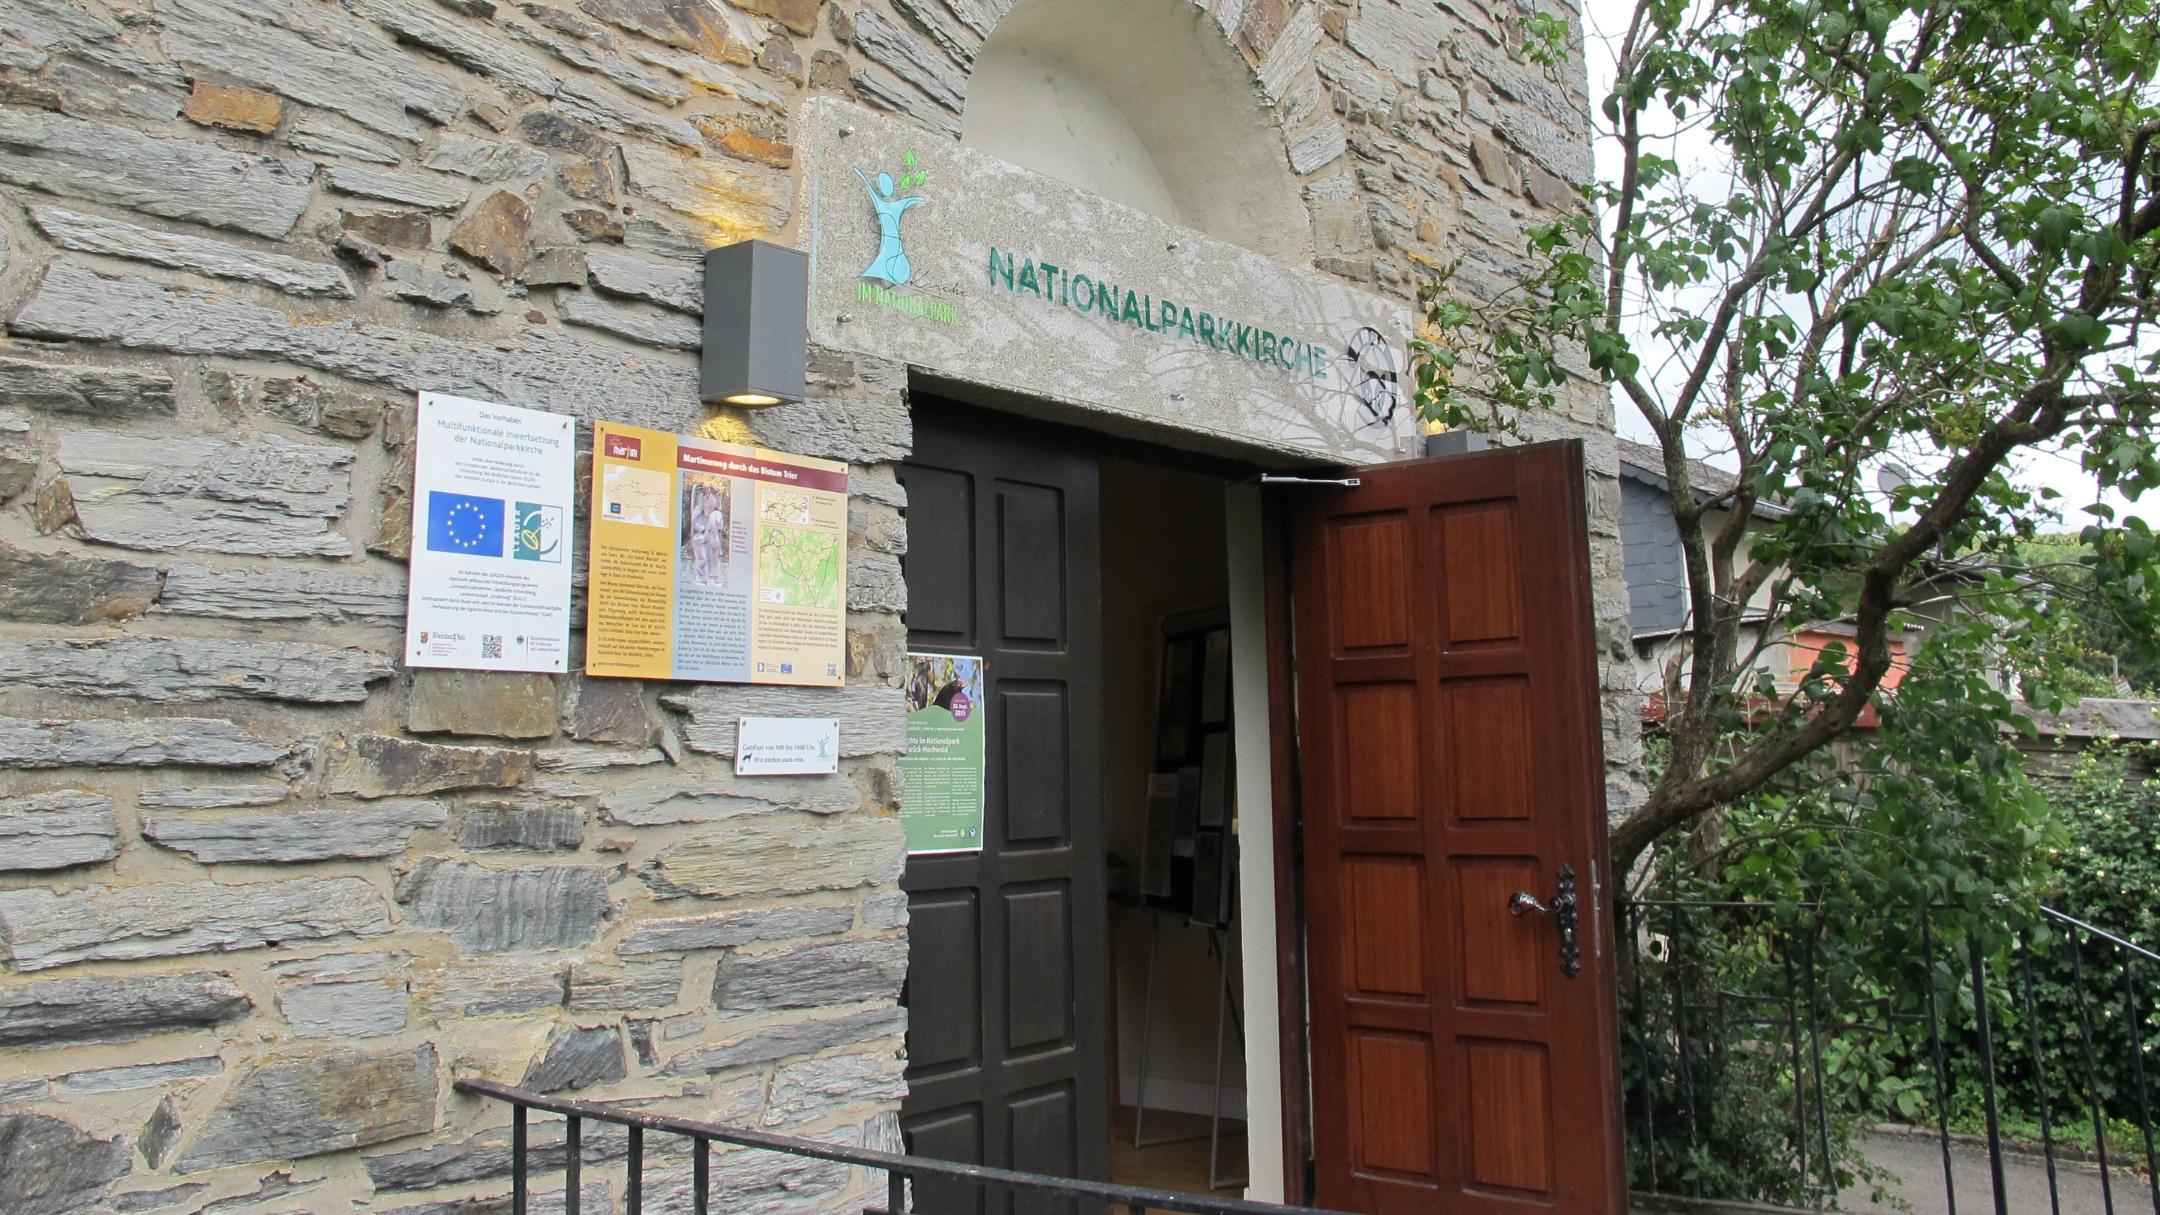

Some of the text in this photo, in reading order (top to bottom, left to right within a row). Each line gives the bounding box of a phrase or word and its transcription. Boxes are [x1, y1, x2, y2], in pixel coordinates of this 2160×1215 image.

[858, 281, 960, 328] IM NATIONALPARK
[989, 246, 1328, 380] NATIONALPARKKIRCHE
[479, 411, 522, 424] Das Vorhaben
[437, 419, 560, 448] Multifunktionale Inwertsetzung
[454, 434, 544, 455] der Nationalparkkirche
[683, 453, 798, 480] Martinusweg durch das Bistum Trier
[926, 736, 960, 746] Nationalpark
